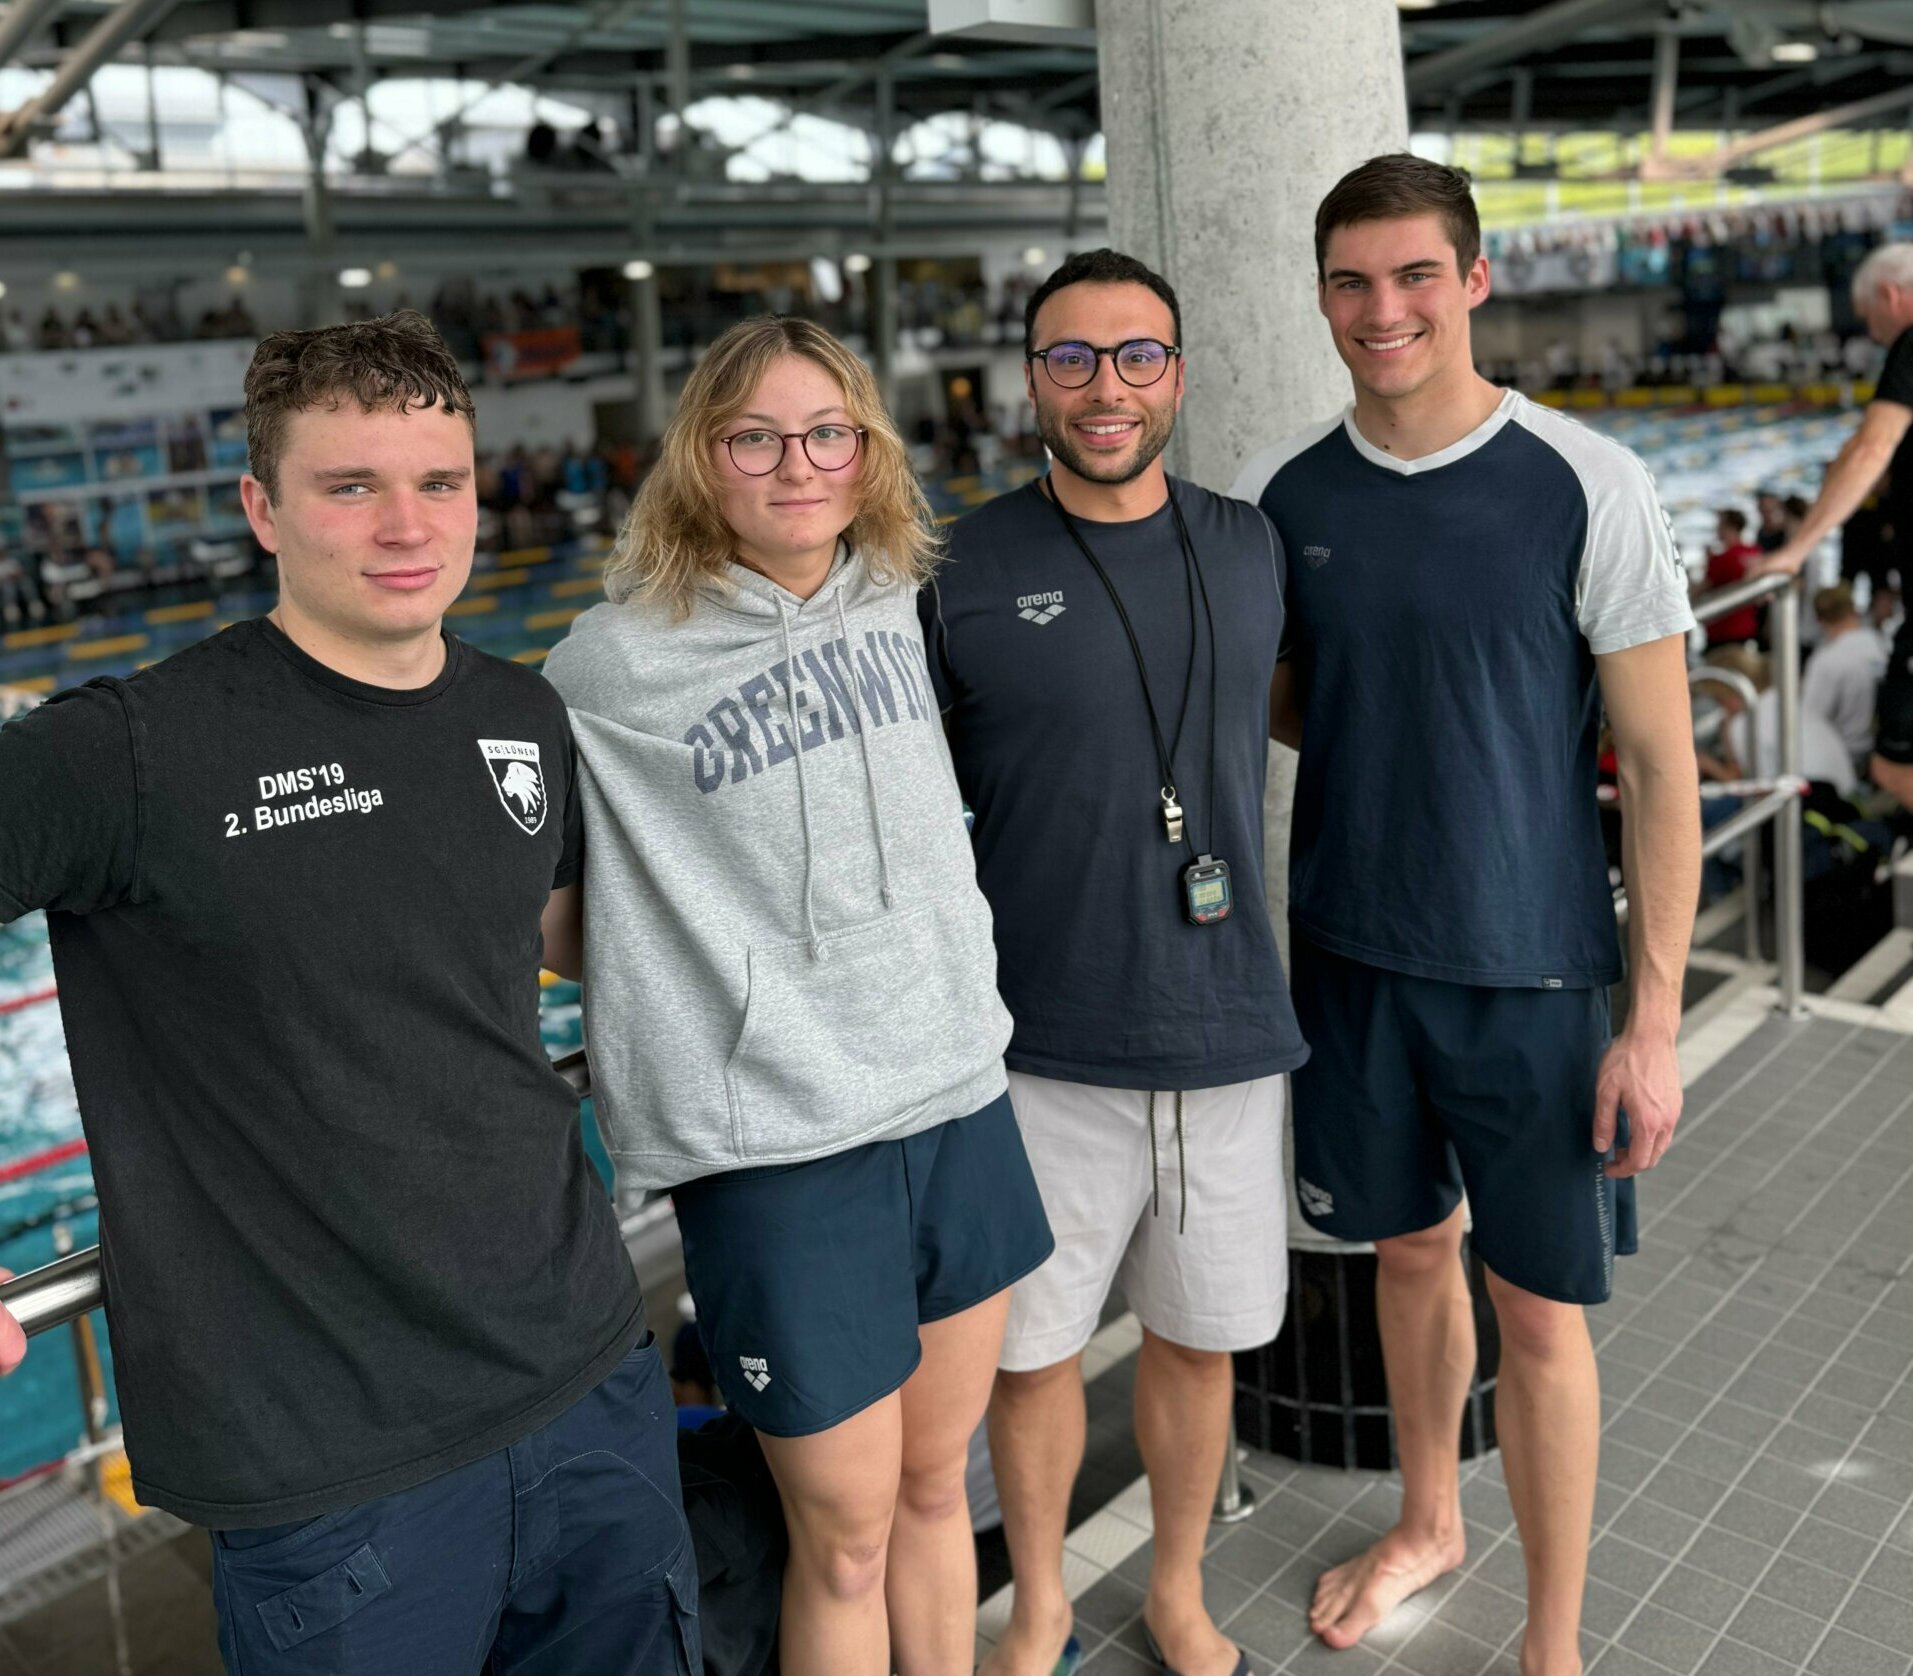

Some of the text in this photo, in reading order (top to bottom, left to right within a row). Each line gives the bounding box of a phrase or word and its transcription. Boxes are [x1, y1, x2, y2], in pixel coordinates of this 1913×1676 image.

[1303, 545, 1331, 559] arena
[1016, 590, 1064, 609] arena
[487, 745, 501, 754] SG
[258, 762, 345, 800] DMS'19
[224, 787, 384, 838] 2. Bundesliga
[739, 1355, 769, 1372] arena
